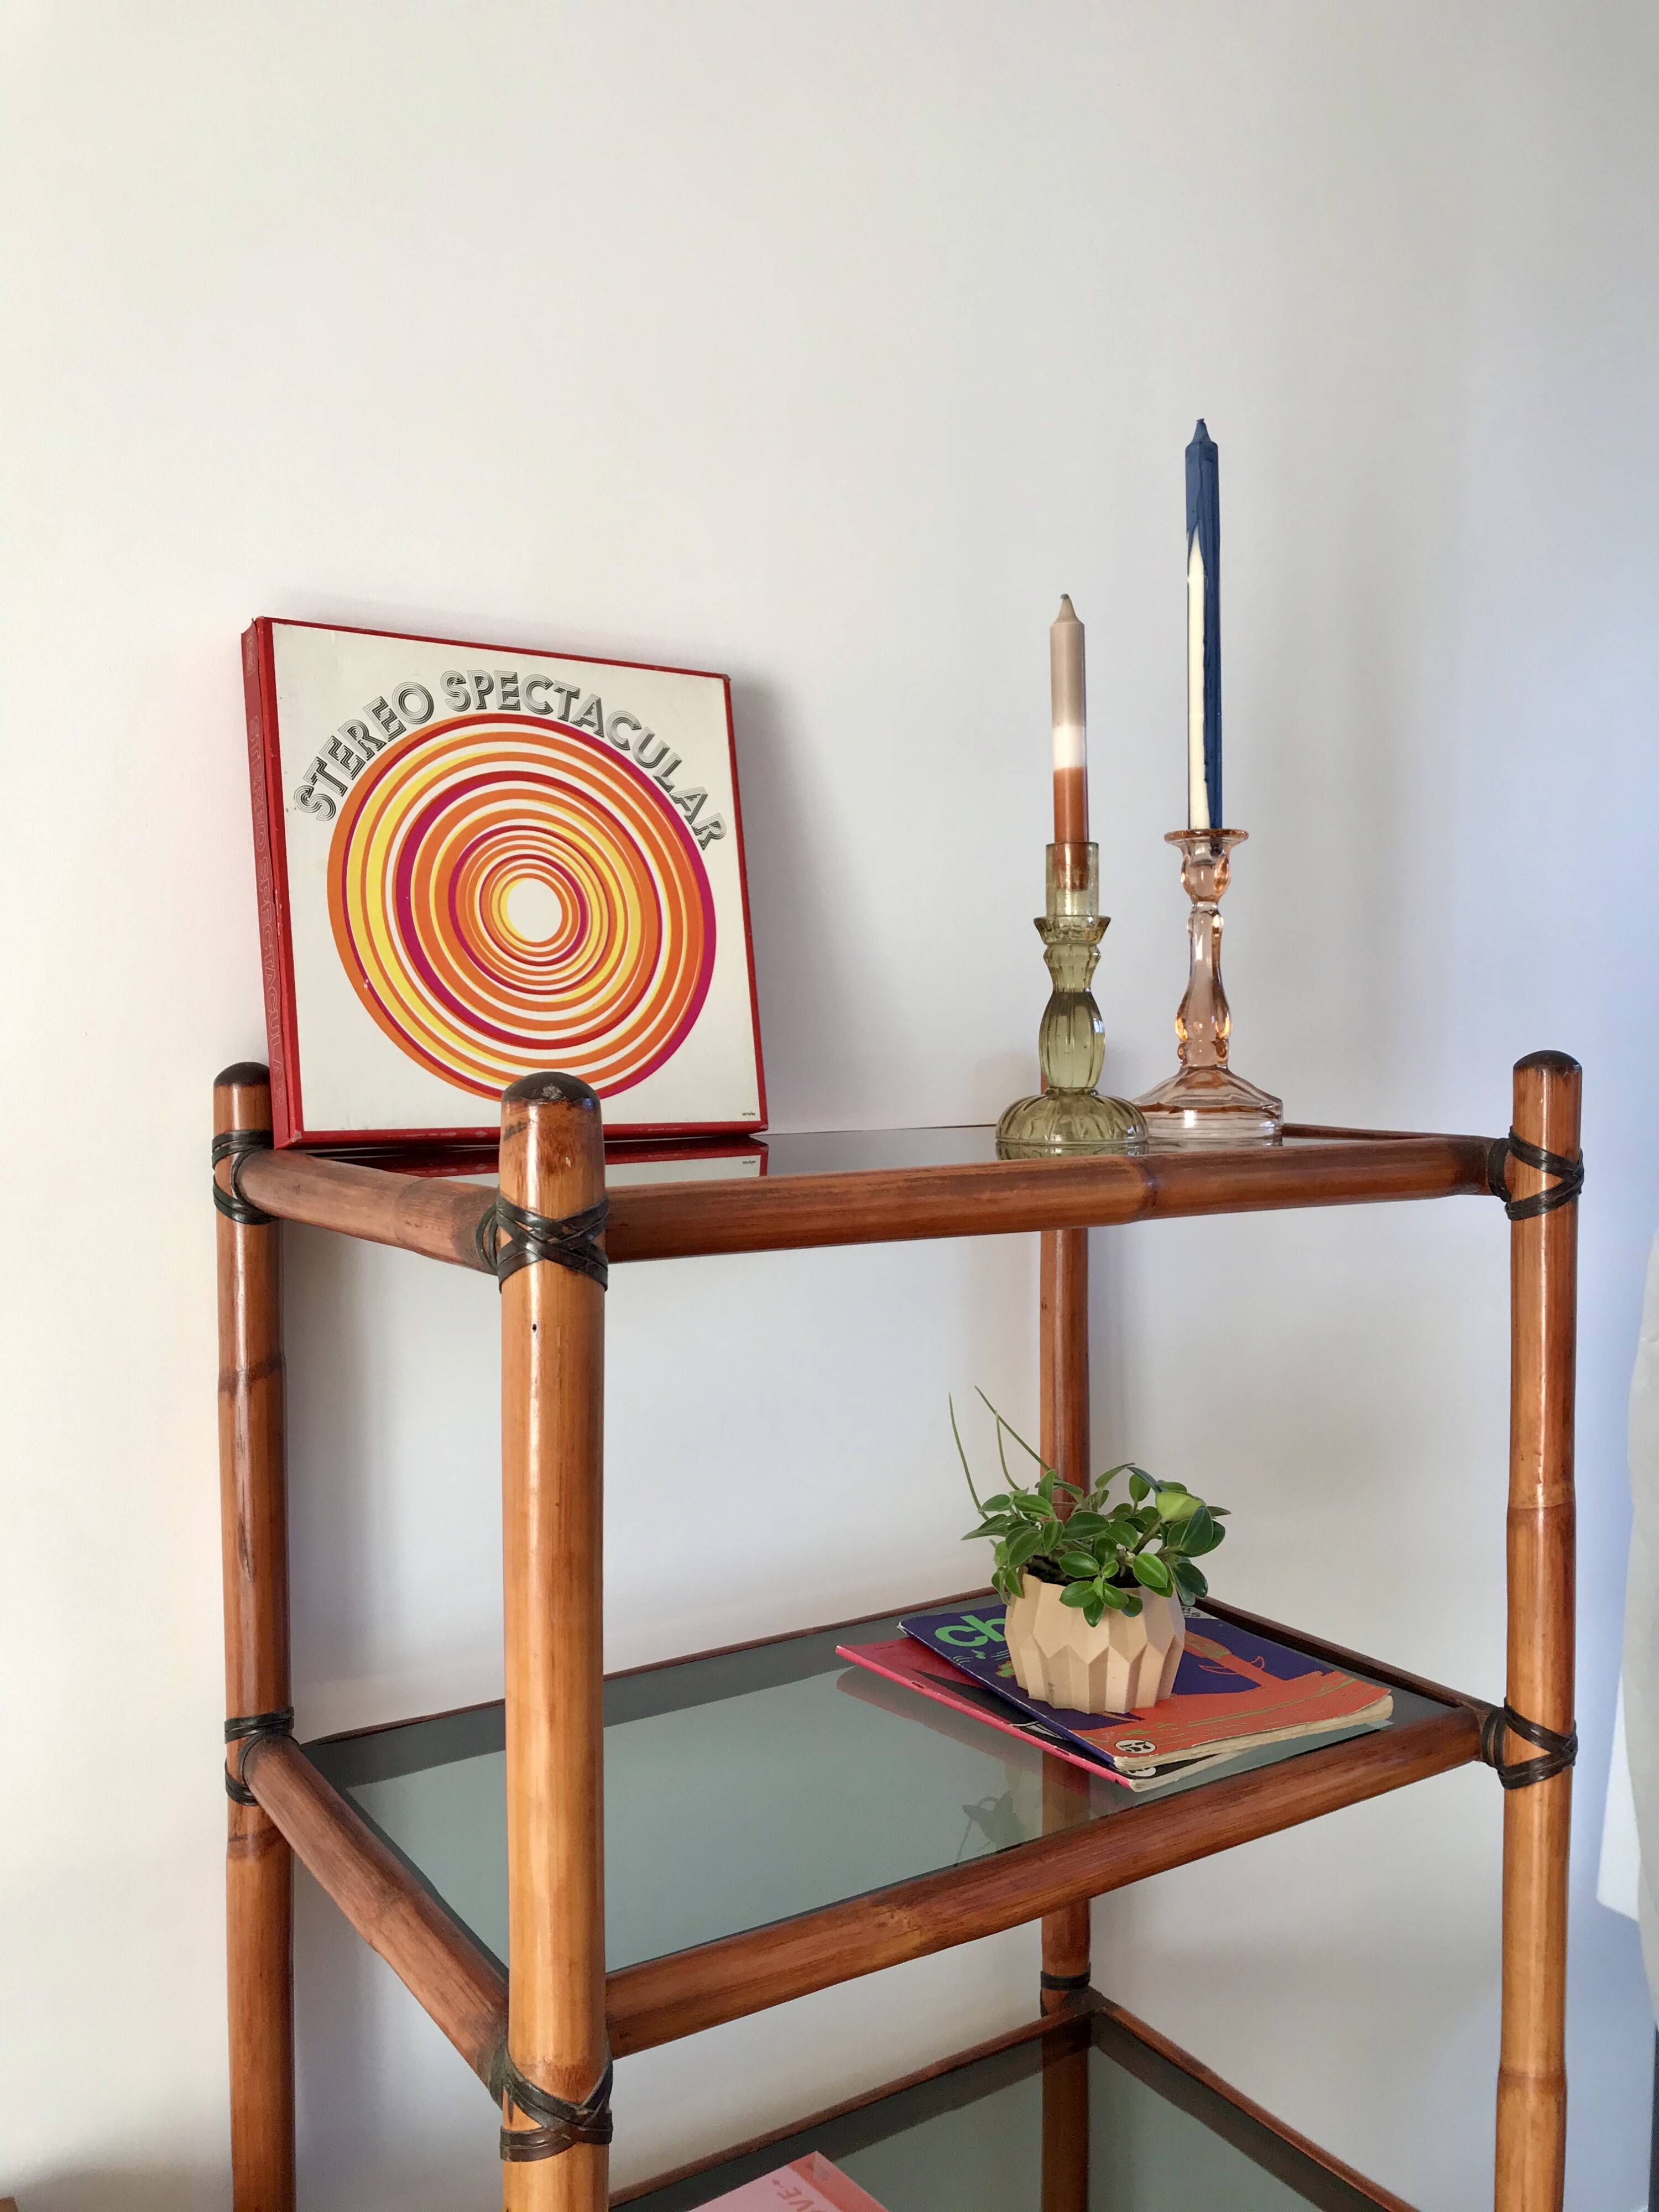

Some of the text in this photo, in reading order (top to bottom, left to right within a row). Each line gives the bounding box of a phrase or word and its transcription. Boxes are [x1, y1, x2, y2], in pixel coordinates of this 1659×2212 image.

[294, 670, 727, 851] STEREO SPECTACULAR
[249, 716, 284, 1108] STEREO SPECTACULAR
[1119, 1742, 1152, 1752] 57
